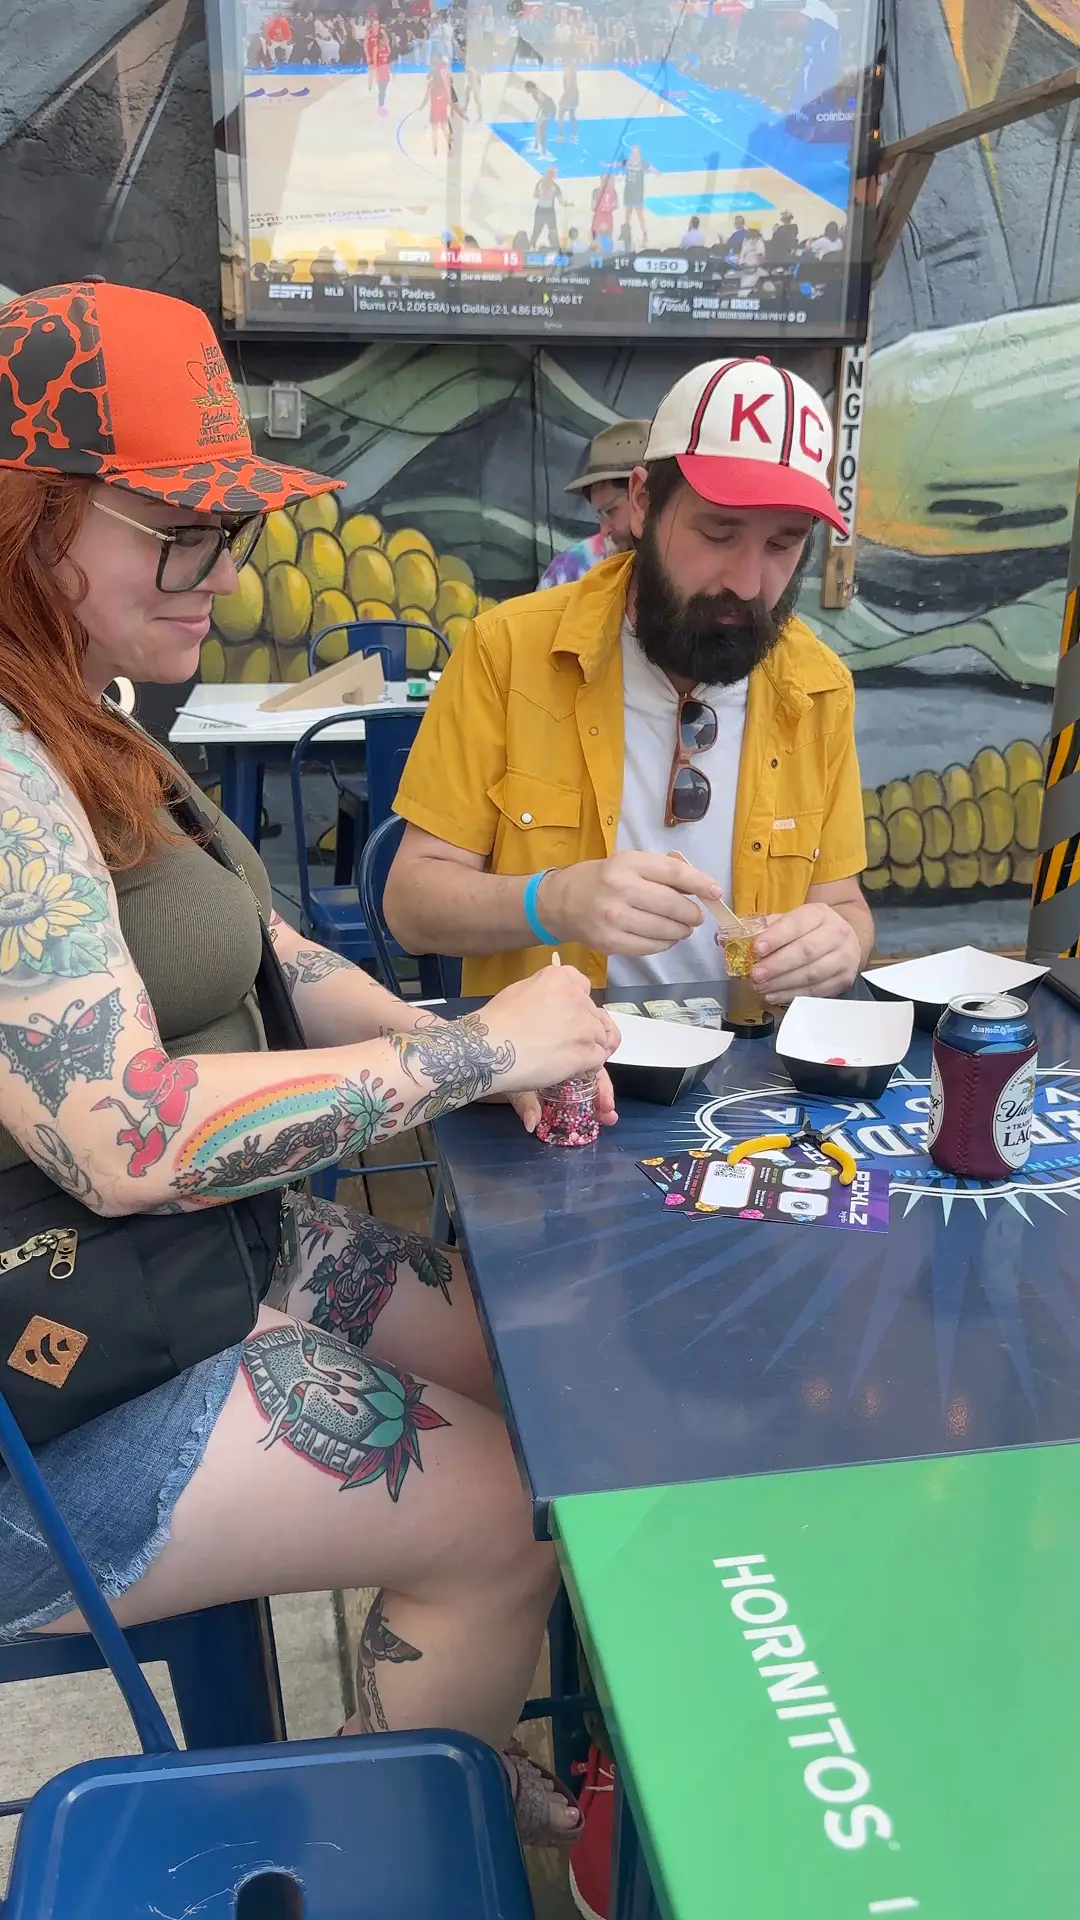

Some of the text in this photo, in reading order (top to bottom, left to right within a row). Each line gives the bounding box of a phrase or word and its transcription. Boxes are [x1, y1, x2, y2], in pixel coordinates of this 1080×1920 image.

[503, 253, 519, 266] 15
[646, 260, 679, 271] 1:50
[694, 260, 707, 272] 17
[268, 284, 313, 299] ESPN
[324, 286, 344, 297] MLB
[359, 286, 384, 298] Reds
[401, 288, 436, 300] Padres
[360, 300, 386, 311] Burns
[712, 1553, 892, 1850] HORNITOS
